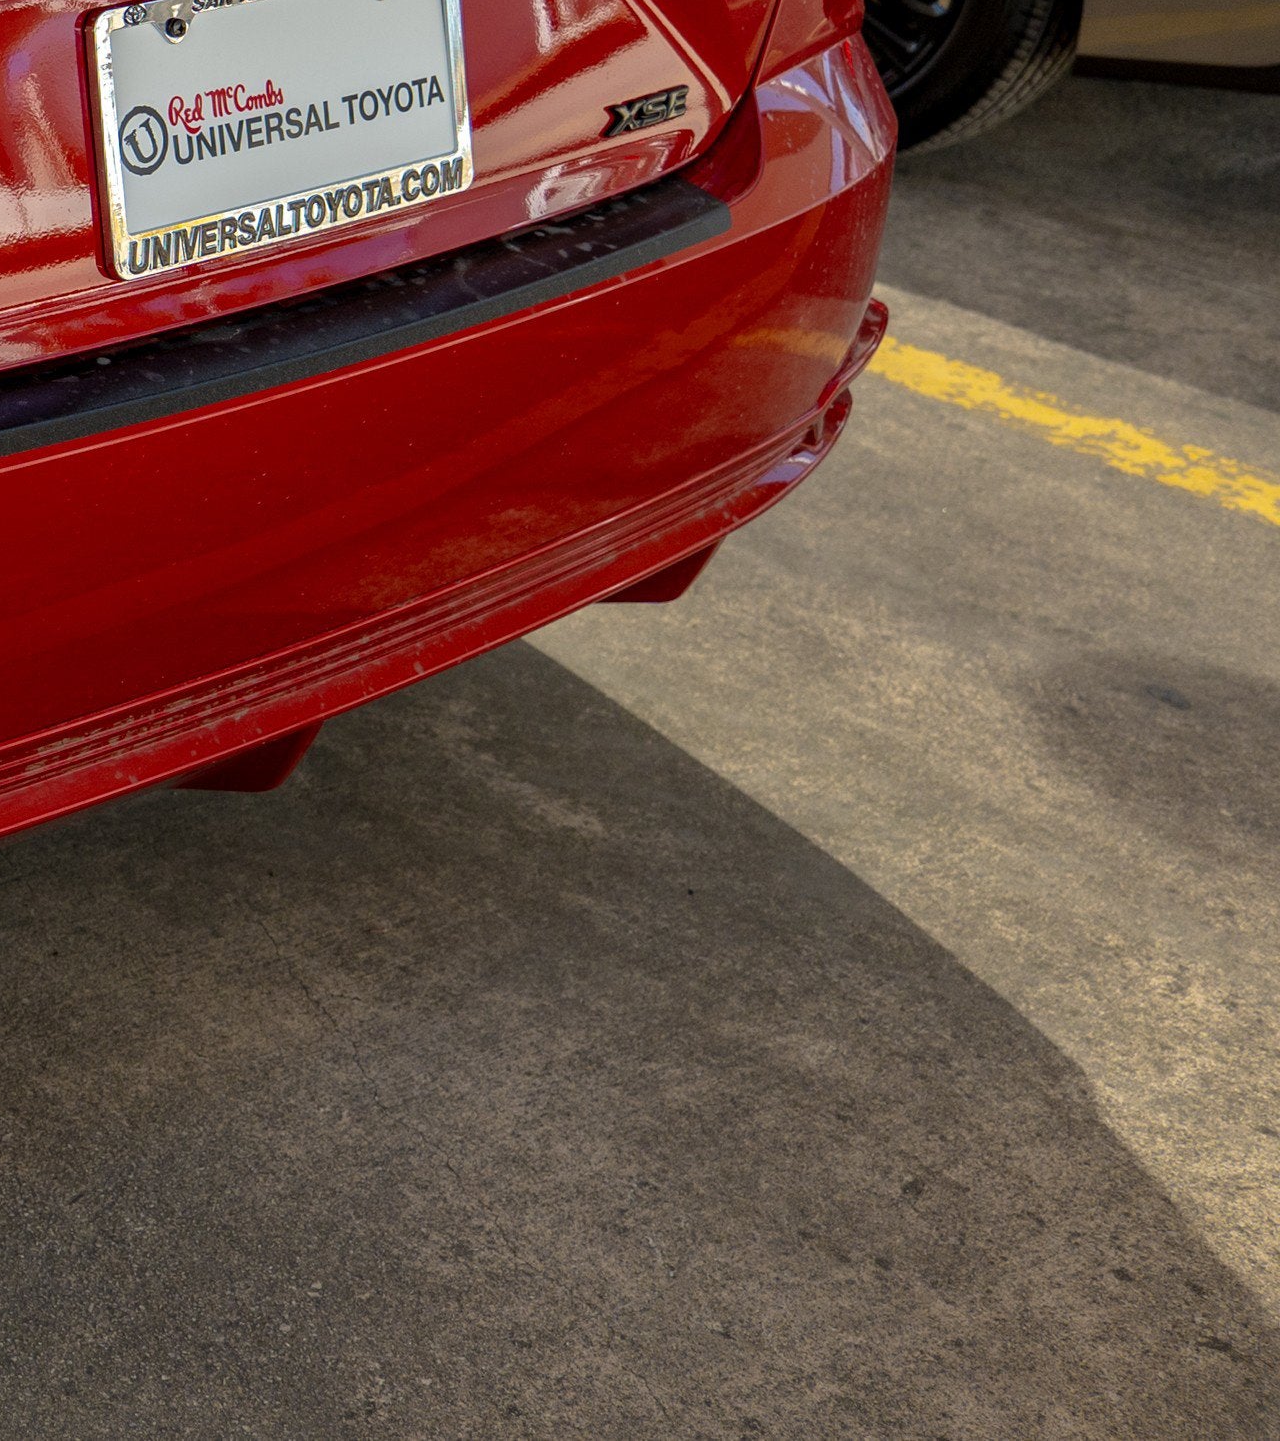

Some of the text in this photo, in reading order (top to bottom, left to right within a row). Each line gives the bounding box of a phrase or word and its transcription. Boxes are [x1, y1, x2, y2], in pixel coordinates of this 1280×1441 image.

[168, 79, 284, 134] Red McCombs
[173, 75, 445, 165] UNIVERSAL TOYOTA
[600, 85, 690, 138] XSE
[128, 157, 464, 275] UNIVERSALTOYOTA.COM
